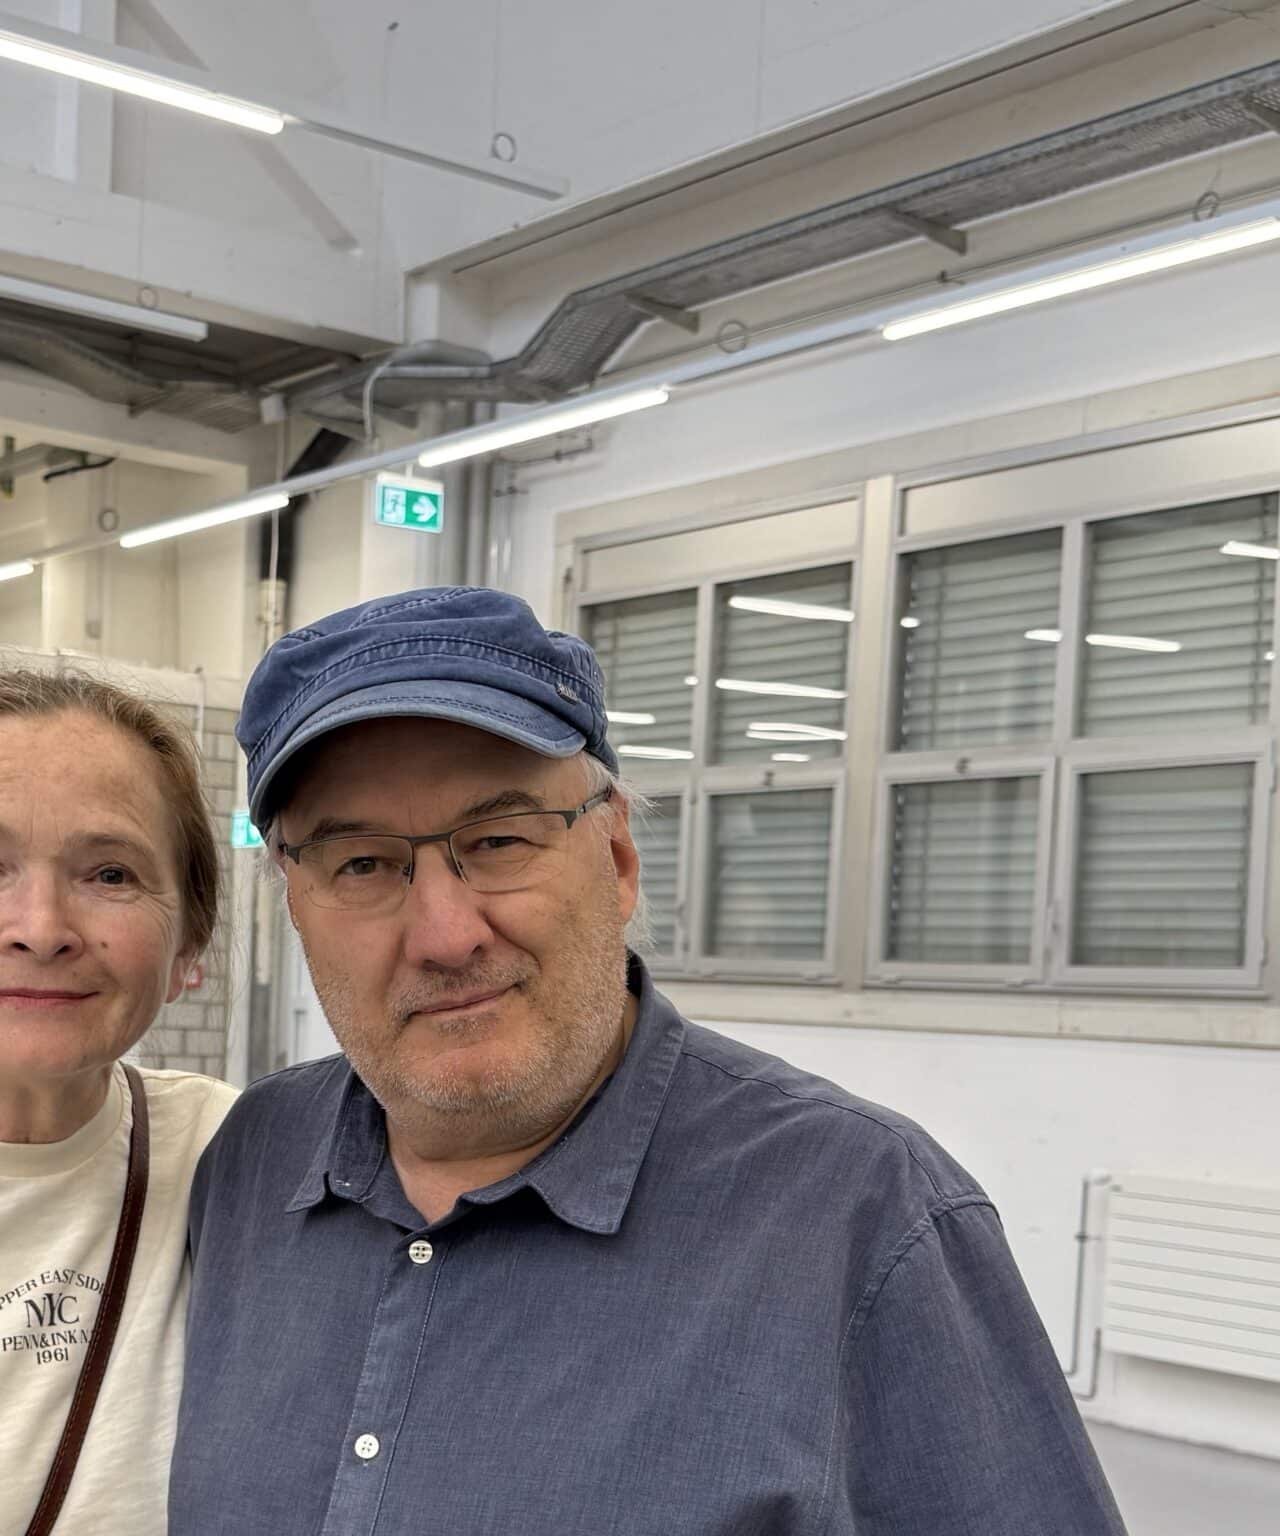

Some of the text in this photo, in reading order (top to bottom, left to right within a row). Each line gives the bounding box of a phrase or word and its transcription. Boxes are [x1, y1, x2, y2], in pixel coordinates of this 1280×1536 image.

[40, 1269, 76, 1285] EAST
[24, 1292, 80, 1328] NYC
[36, 1347, 69, 1365] 1961
